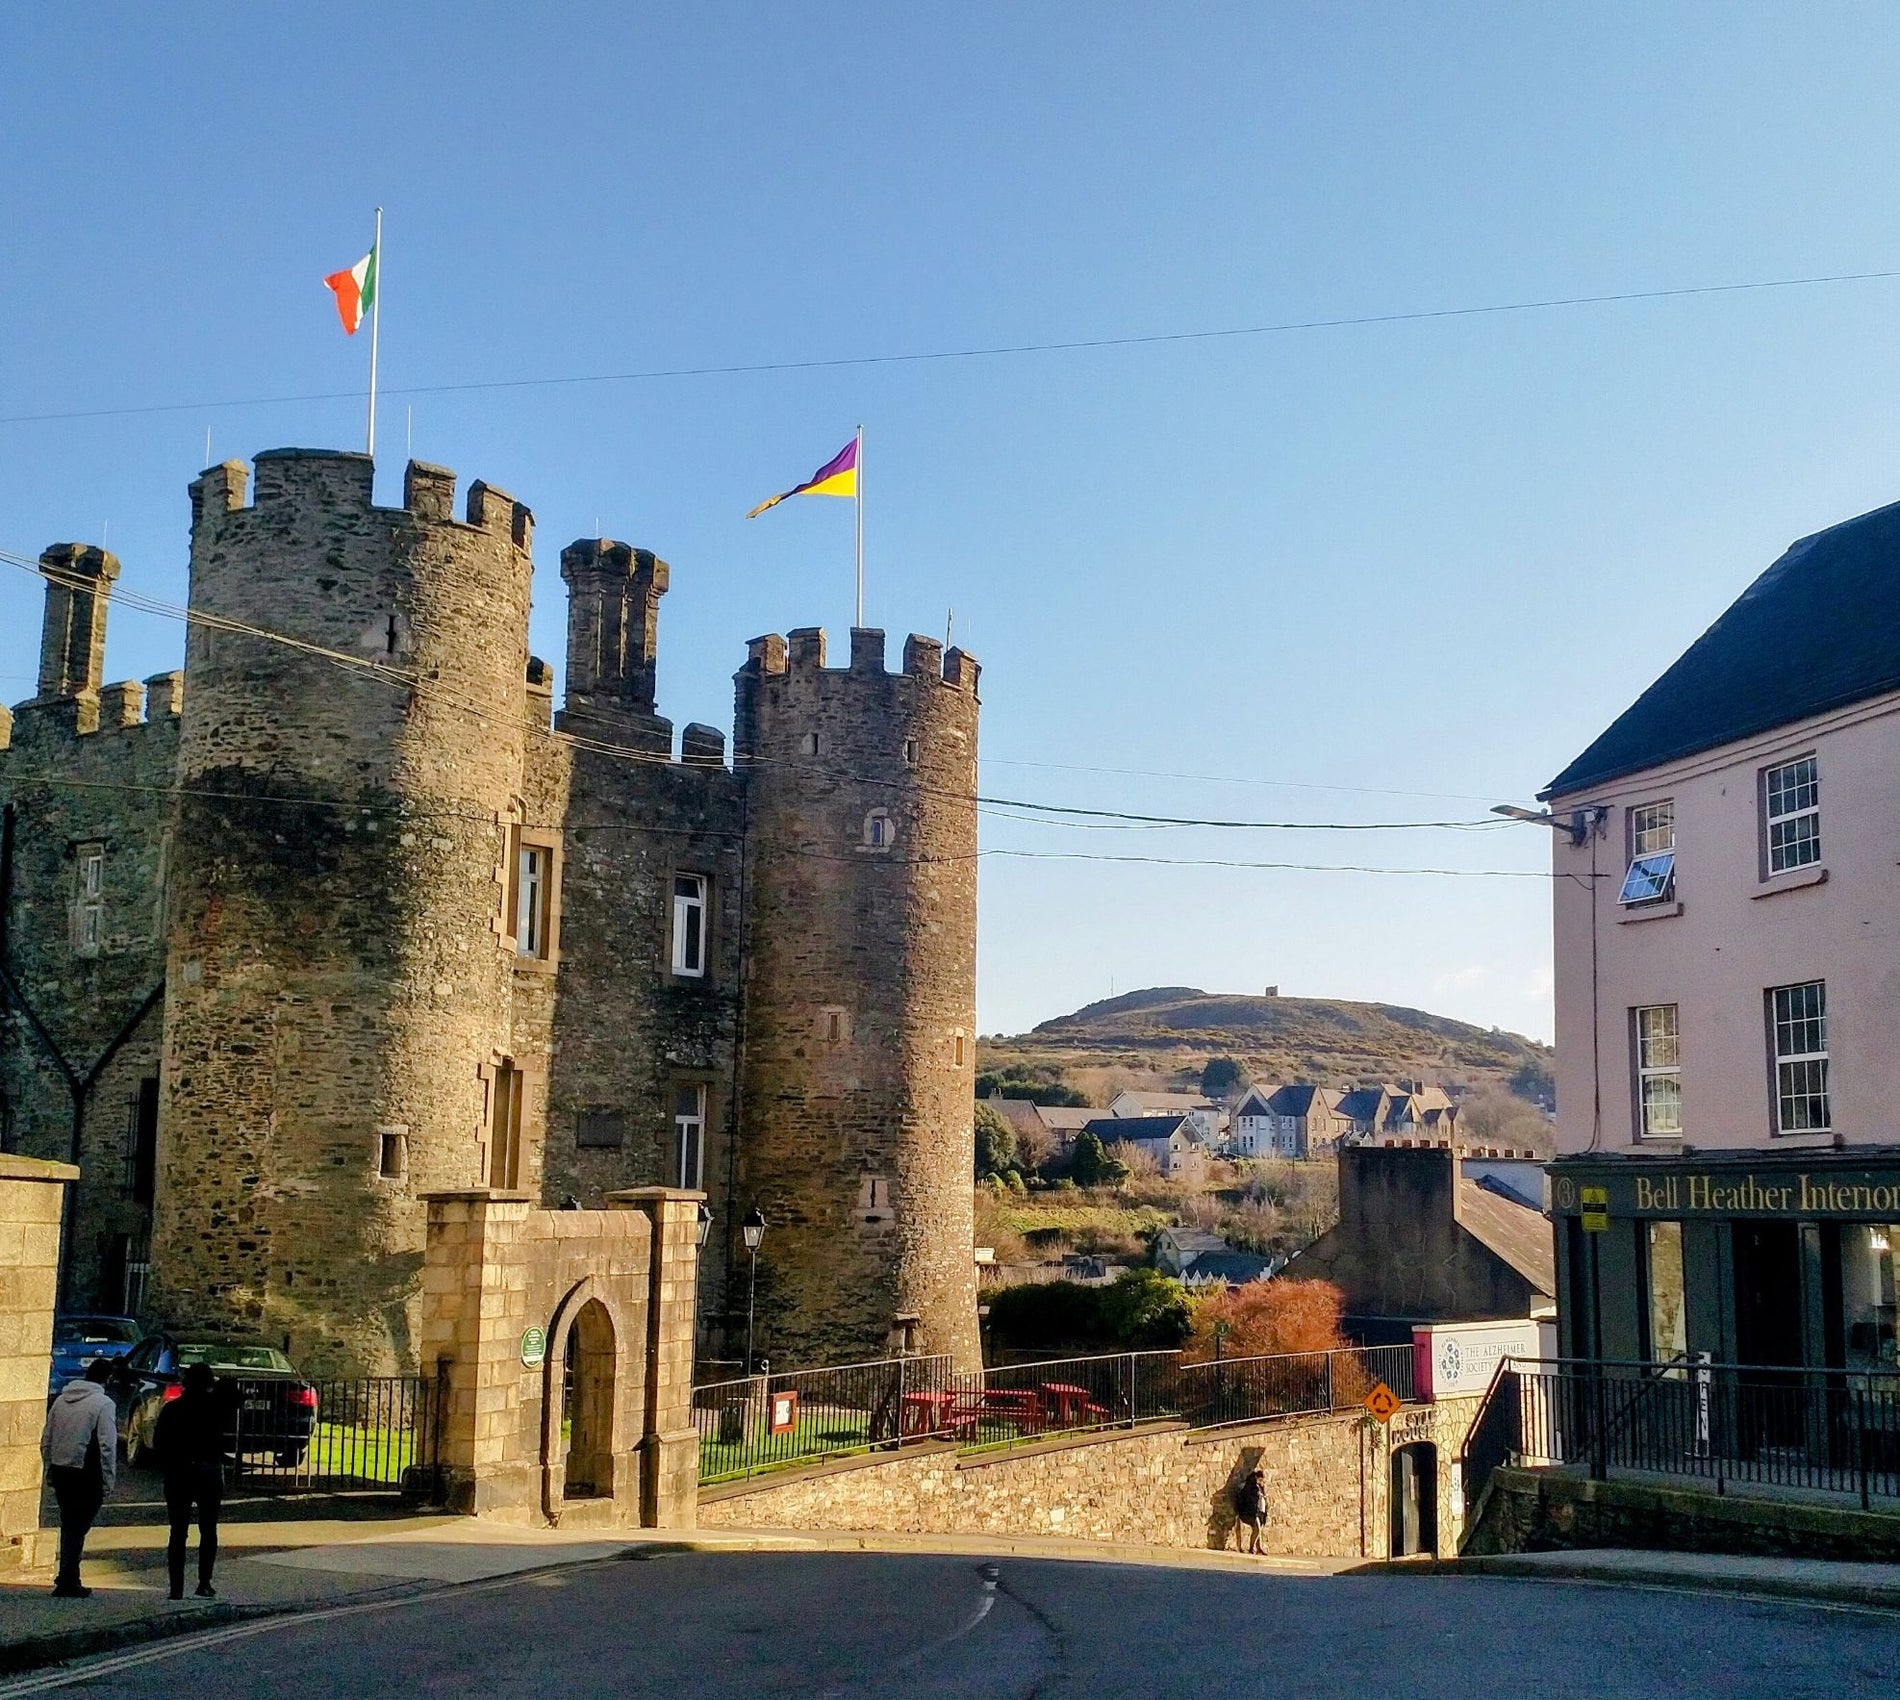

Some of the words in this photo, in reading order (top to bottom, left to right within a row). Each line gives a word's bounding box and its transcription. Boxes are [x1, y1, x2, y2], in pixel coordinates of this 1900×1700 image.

[1636, 1176, 1679, 1210] Bell
[1687, 1174, 1792, 1211] Heather
[1465, 1346, 1480, 1358] THE
[1483, 1343, 1526, 1357] ALZHEIMER
[1465, 1360, 1493, 1374] SOCIETY
[1391, 1425, 1435, 1445] HOUSE
